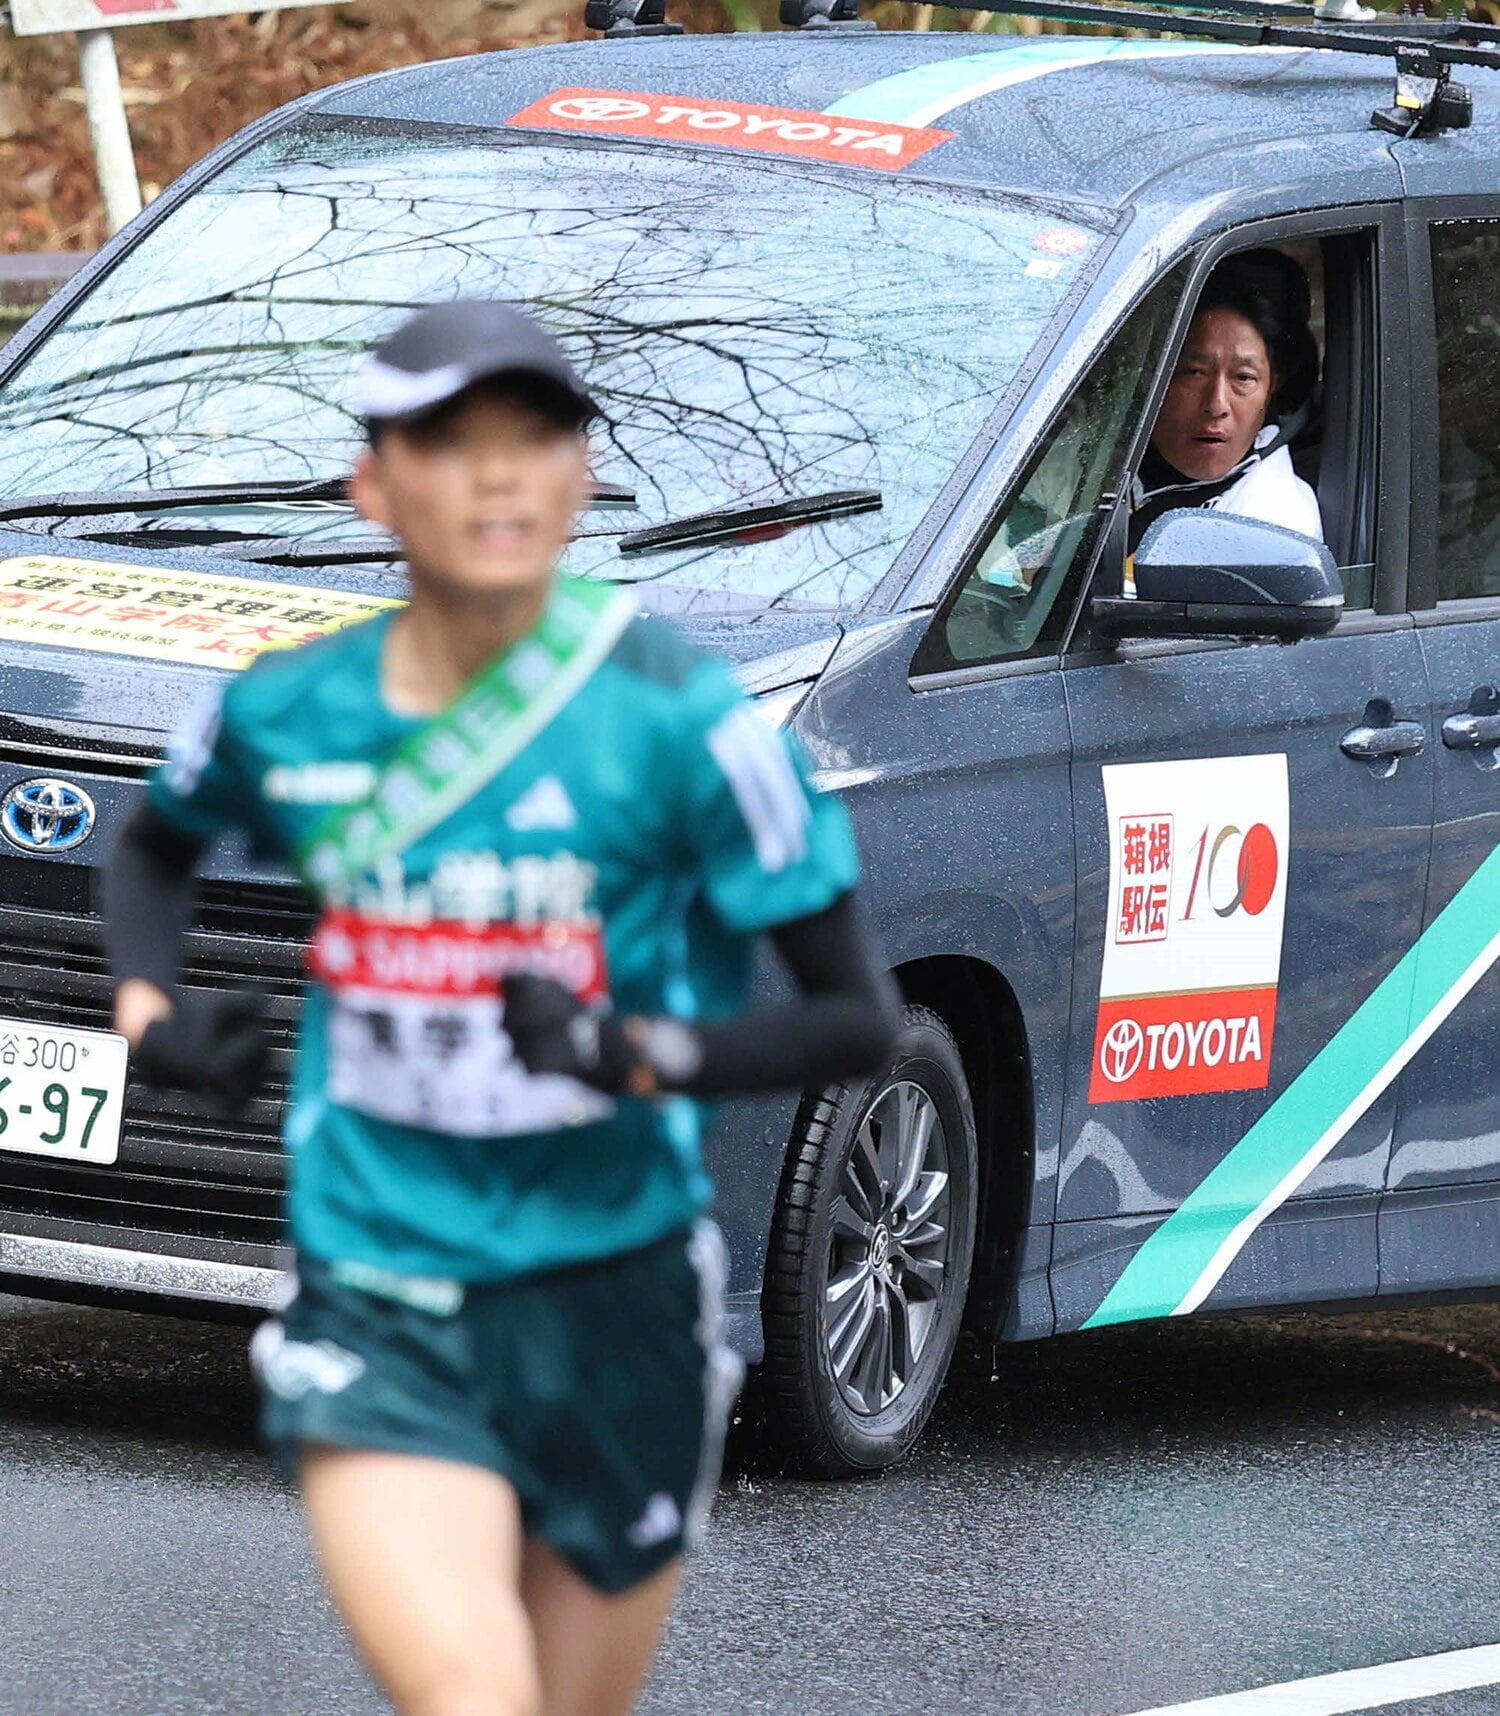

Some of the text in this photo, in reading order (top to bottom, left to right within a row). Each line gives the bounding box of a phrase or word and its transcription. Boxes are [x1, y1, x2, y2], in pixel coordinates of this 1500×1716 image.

[655, 105, 905, 156] TOYOTA
[3, 575, 346, 625] 運営管理車
[1123, 822, 1171, 875] 箱根
[1118, 883, 1168, 935] 駅伝
[1145, 1015, 1263, 1072] TOYOTA
